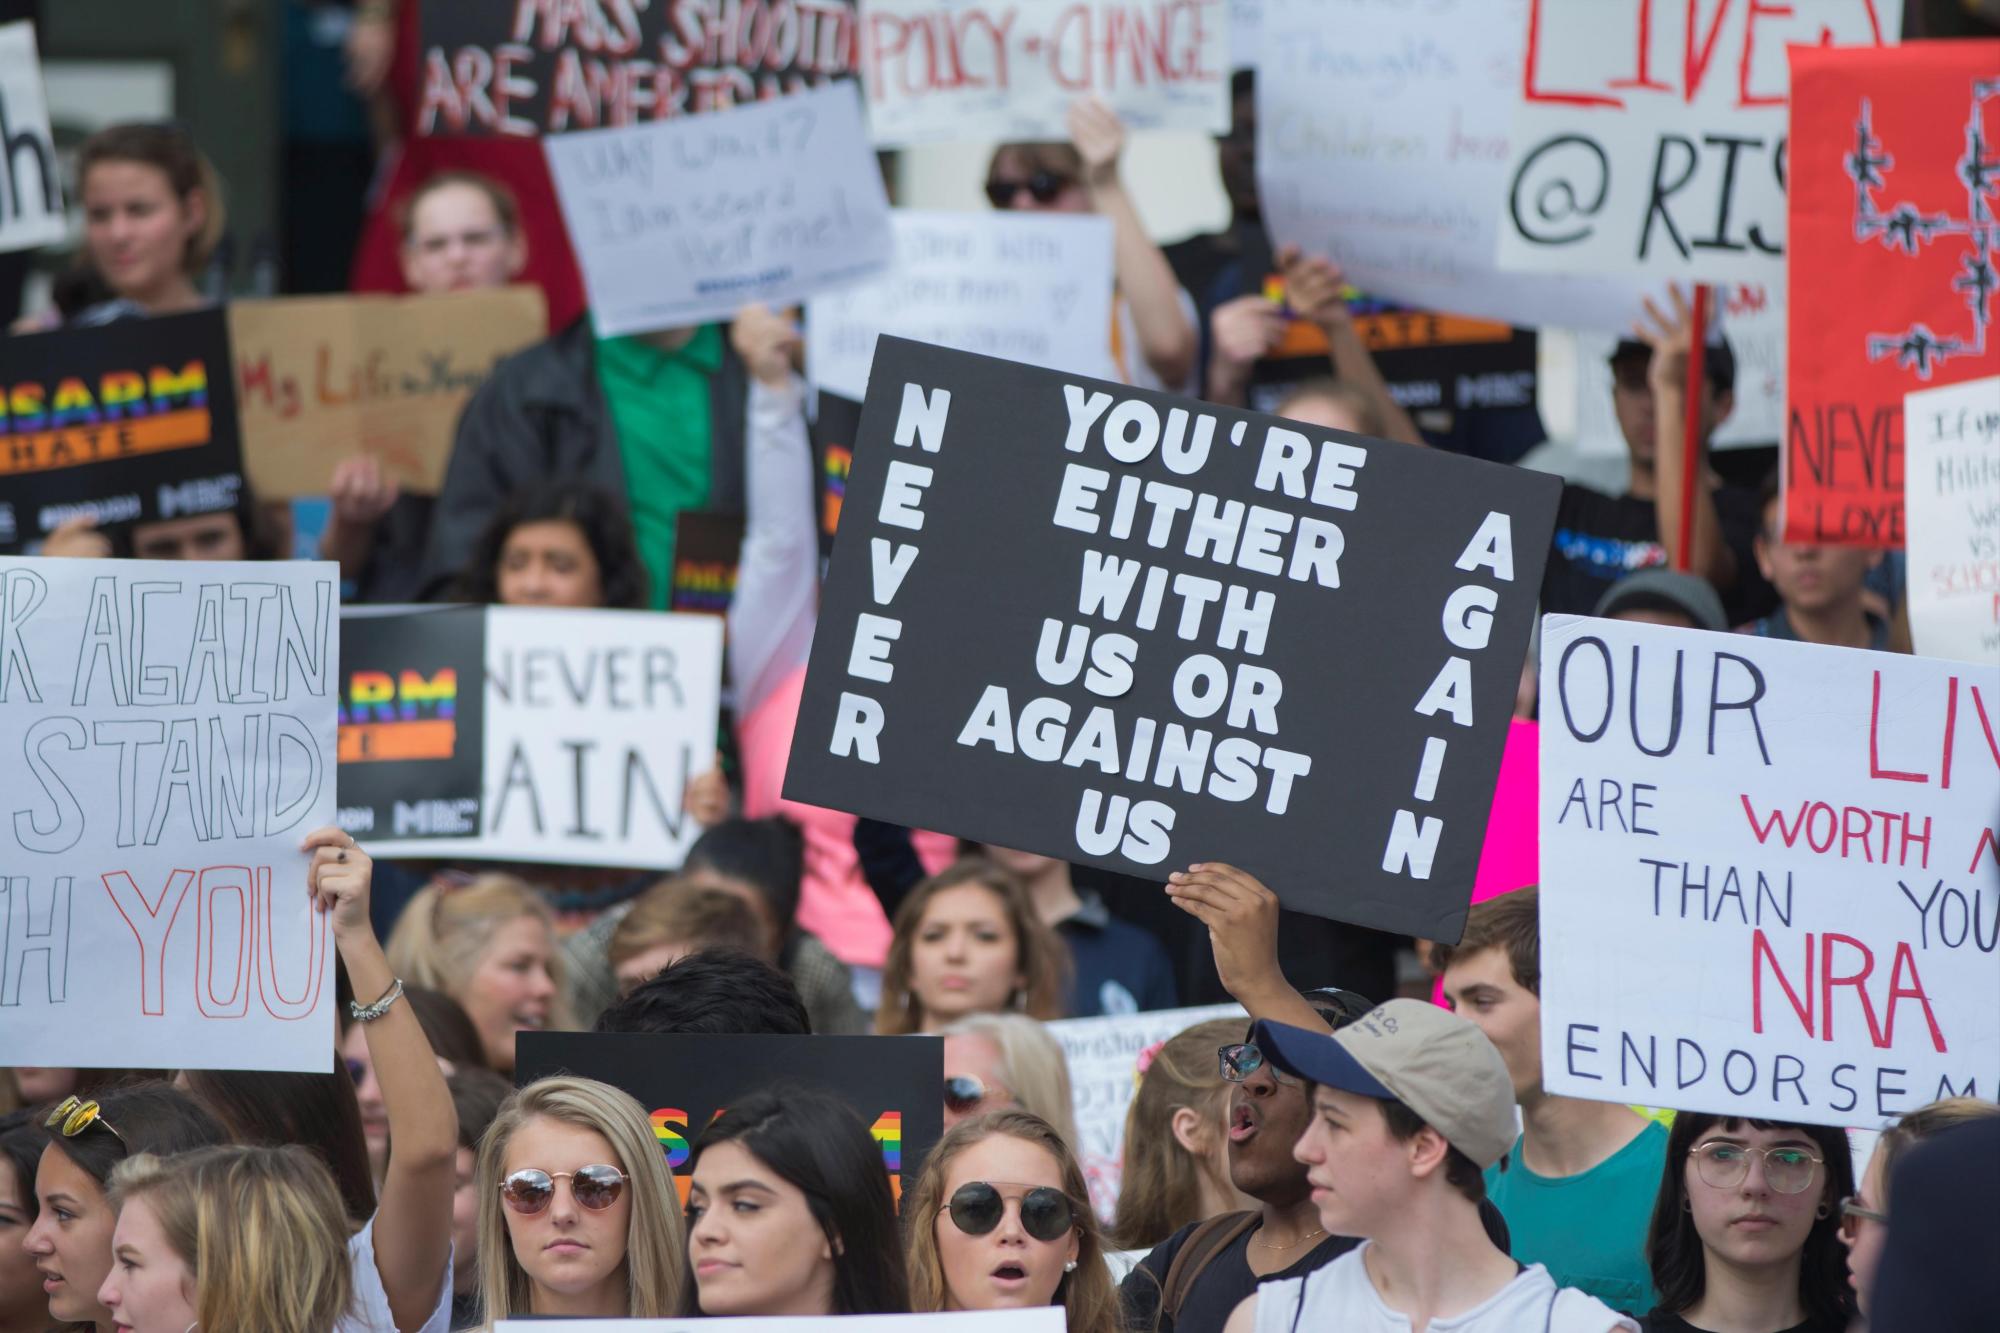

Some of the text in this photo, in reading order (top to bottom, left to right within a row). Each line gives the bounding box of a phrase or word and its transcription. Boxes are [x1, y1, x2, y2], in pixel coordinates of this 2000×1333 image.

[417, 43, 541, 138] ARE
[1523, 0, 1884, 108] LIVE
[1508, 132, 1612, 247] @
[0, 358, 208, 434] SARM
[1063, 383, 1368, 511] YOU'RE
[829, 382, 952, 764] NEVER
[1052, 462, 1346, 588] EITHER
[0, 567, 332, 707] R AGAIN
[1078, 549, 1276, 656] WITH
[1034, 617, 1283, 736] US OR
[1381, 511, 1515, 880] AGAIN
[1557, 635, 1773, 767] OUR
[13, 712, 324, 855] STAND
[490, 739, 693, 843] AIN
[956, 685, 1312, 815] AGAINST
[1074, 789, 1177, 865] US
[1558, 777, 1660, 836] ARE
[1740, 794, 1932, 869] WORTH
[0, 865, 327, 1021] H YOU
[1639, 857, 1793, 928] THAN
[1752, 928, 1949, 1054] NRA
[1565, 1022, 2000, 1118] ENDORSEM
